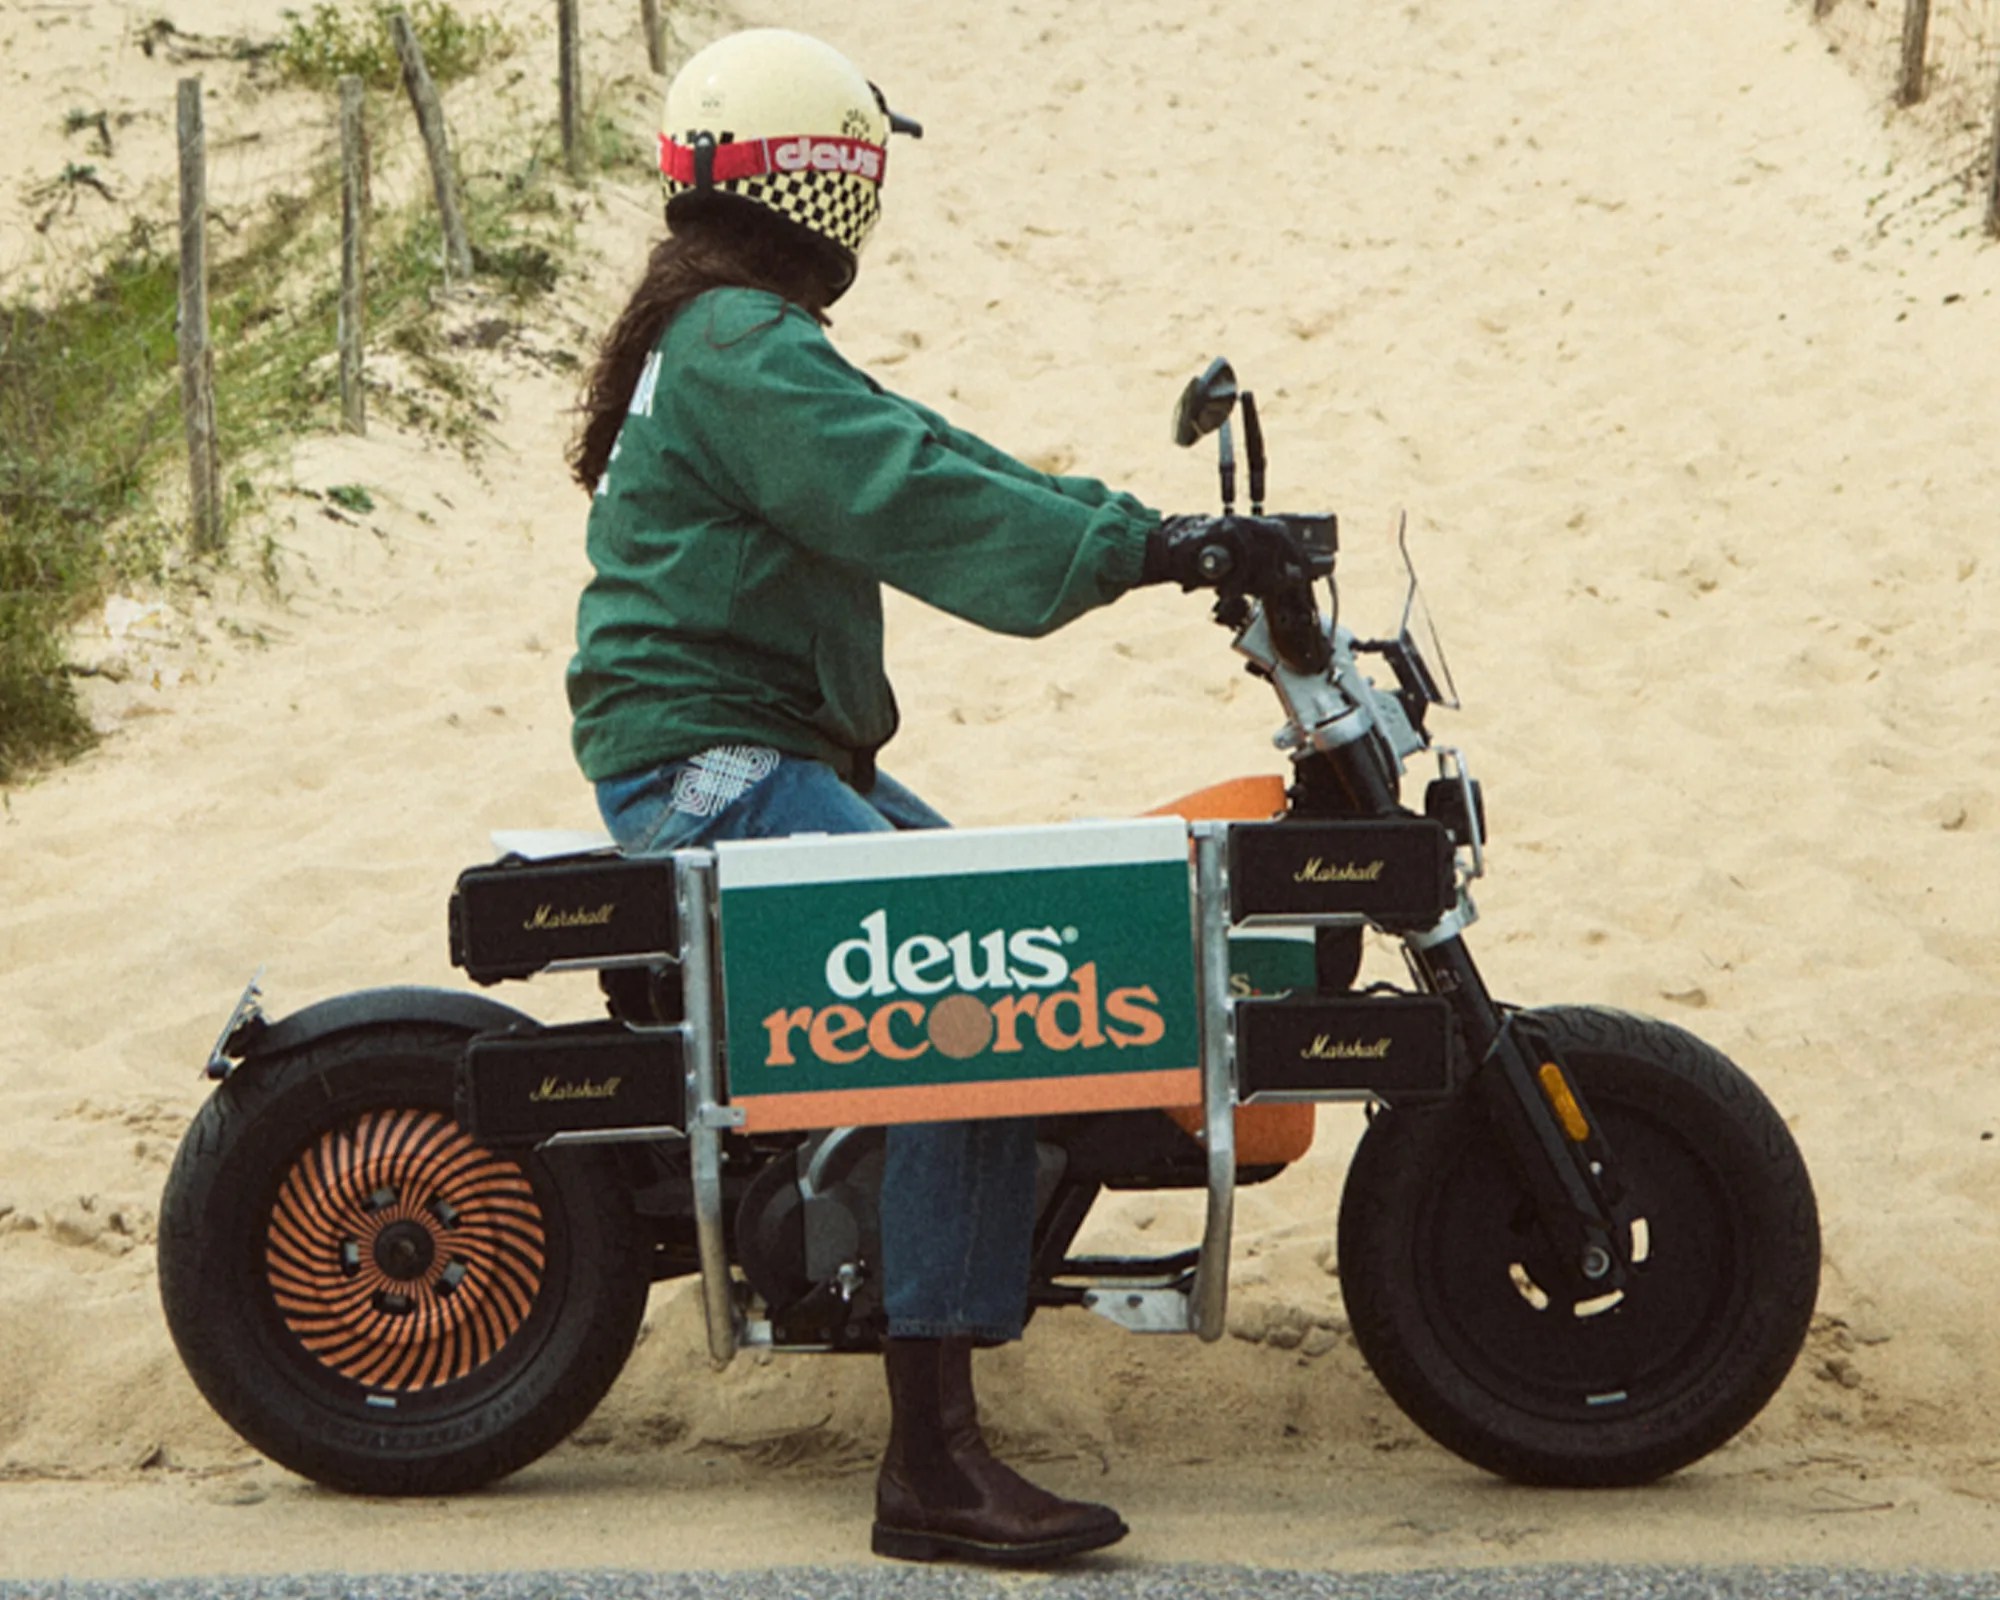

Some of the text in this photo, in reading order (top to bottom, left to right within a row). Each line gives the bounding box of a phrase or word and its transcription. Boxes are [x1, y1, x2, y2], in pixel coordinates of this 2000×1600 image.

[775, 137, 879, 178] deus
[1293, 857, 1385, 883] Marshall
[523, 904, 614, 930] Marshall
[1300, 1034, 1392, 1060] Marshall
[529, 1076, 621, 1102] Marshall
